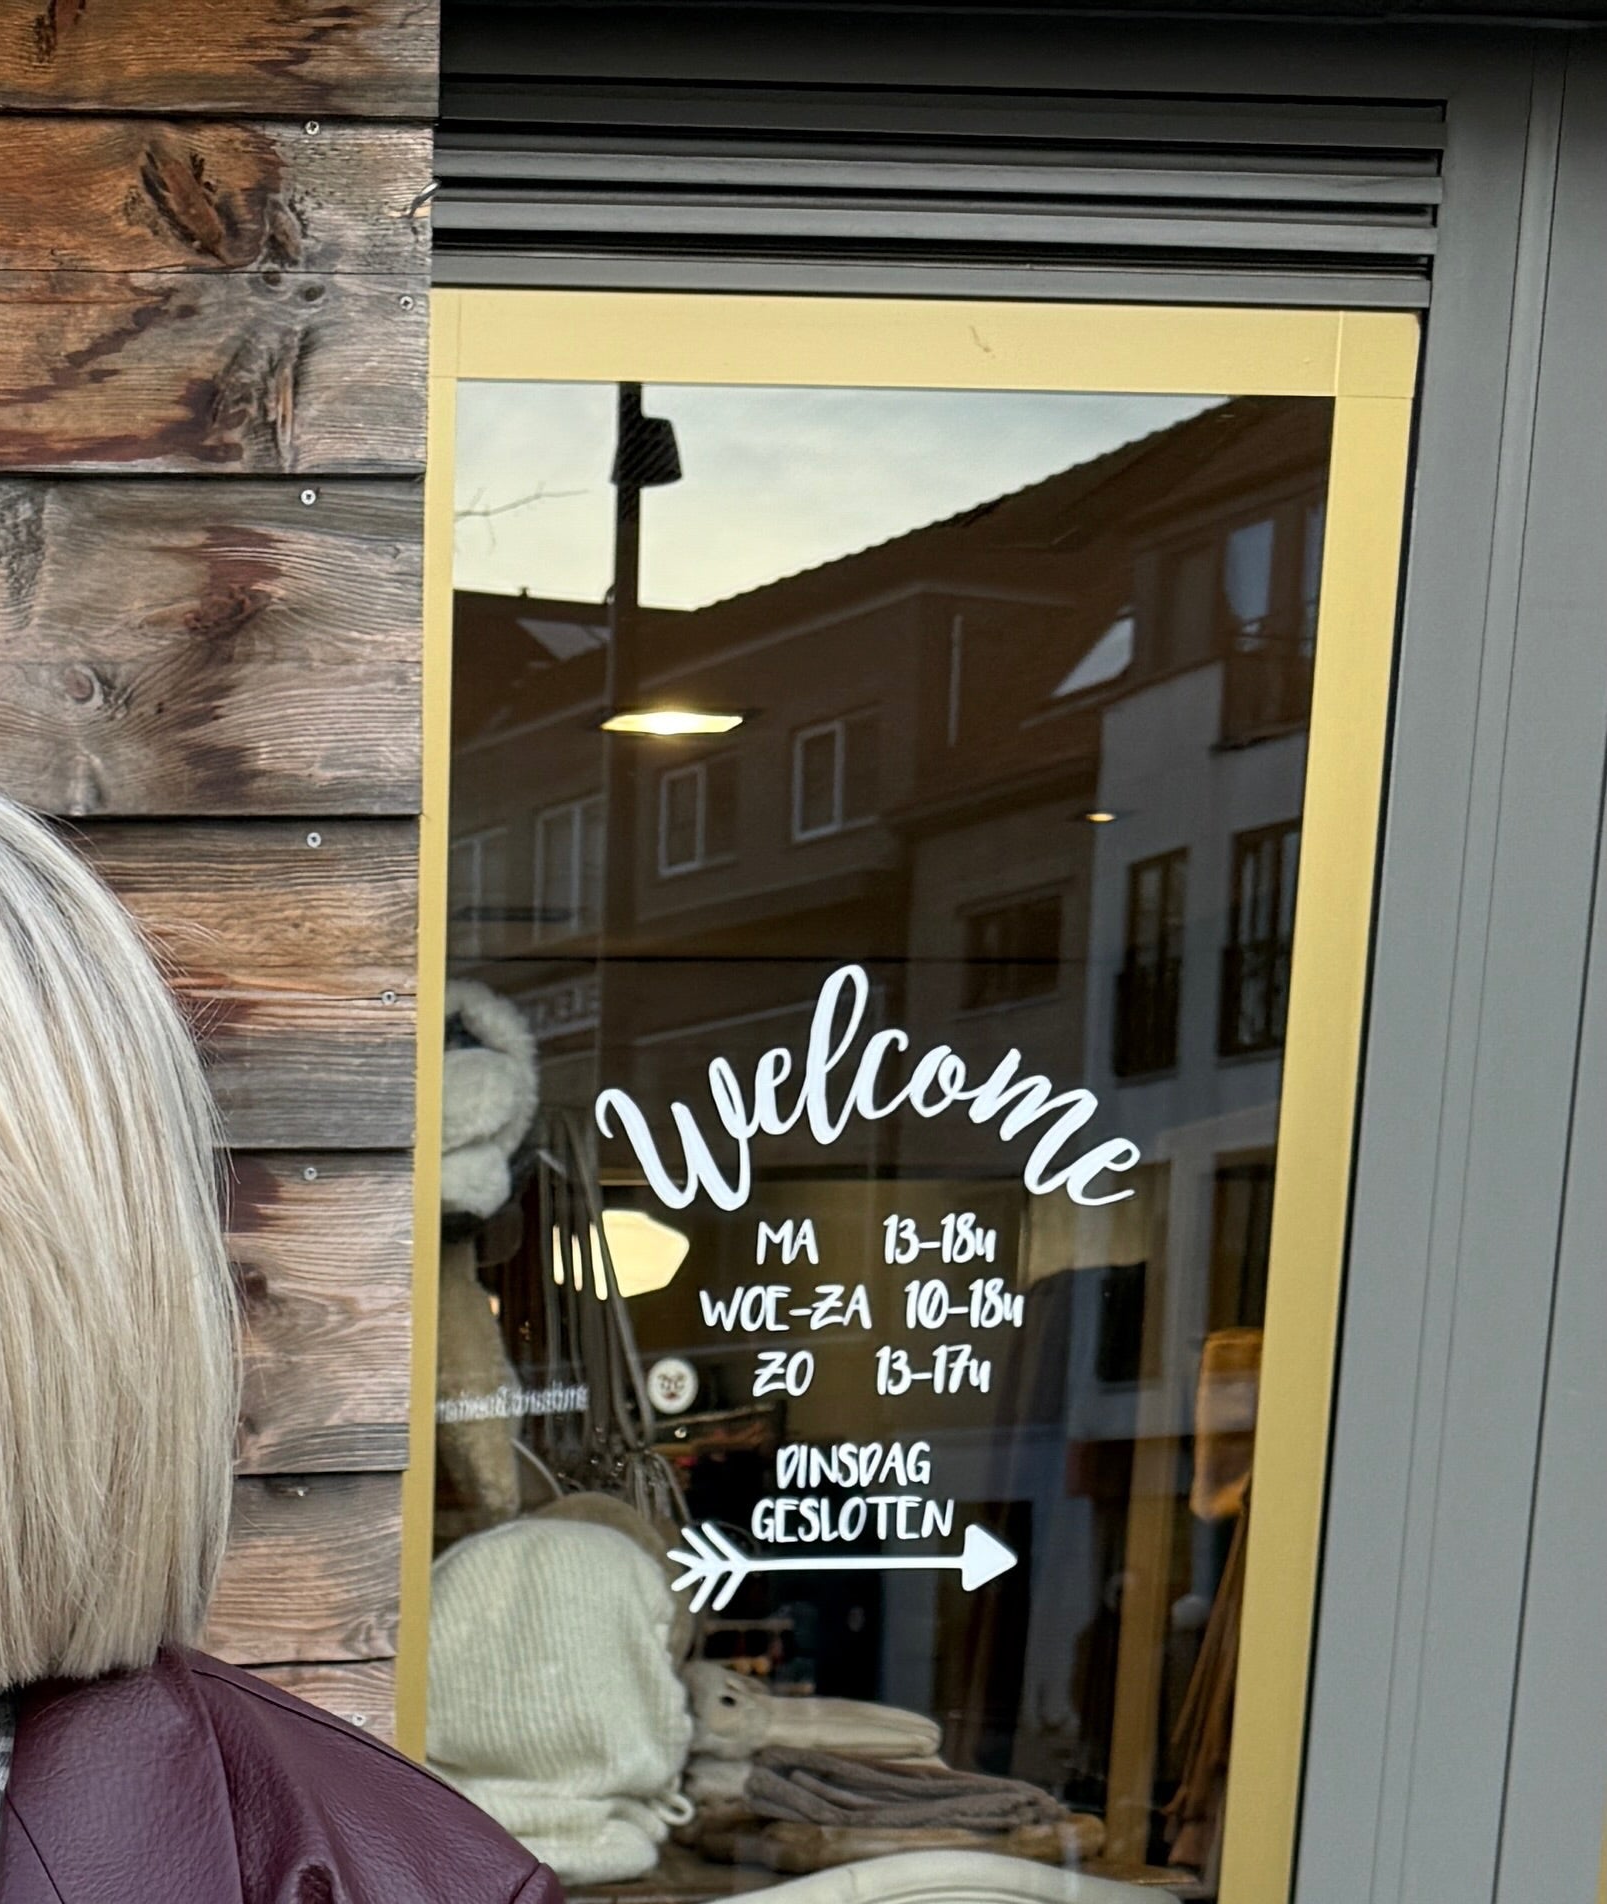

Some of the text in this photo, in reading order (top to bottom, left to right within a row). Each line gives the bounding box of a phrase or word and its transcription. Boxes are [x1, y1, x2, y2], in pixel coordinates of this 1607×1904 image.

[595, 964, 1142, 1211] Welcome
[756, 1212, 996, 1265] MA 13-18u
[699, 1277, 1025, 1332] WOE-ZA 10-18u
[752, 1344, 991, 1397] ZO 13-17u
[776, 1441, 931, 1489] DINSDAG
[751, 1495, 955, 1543] GESLOTEN
